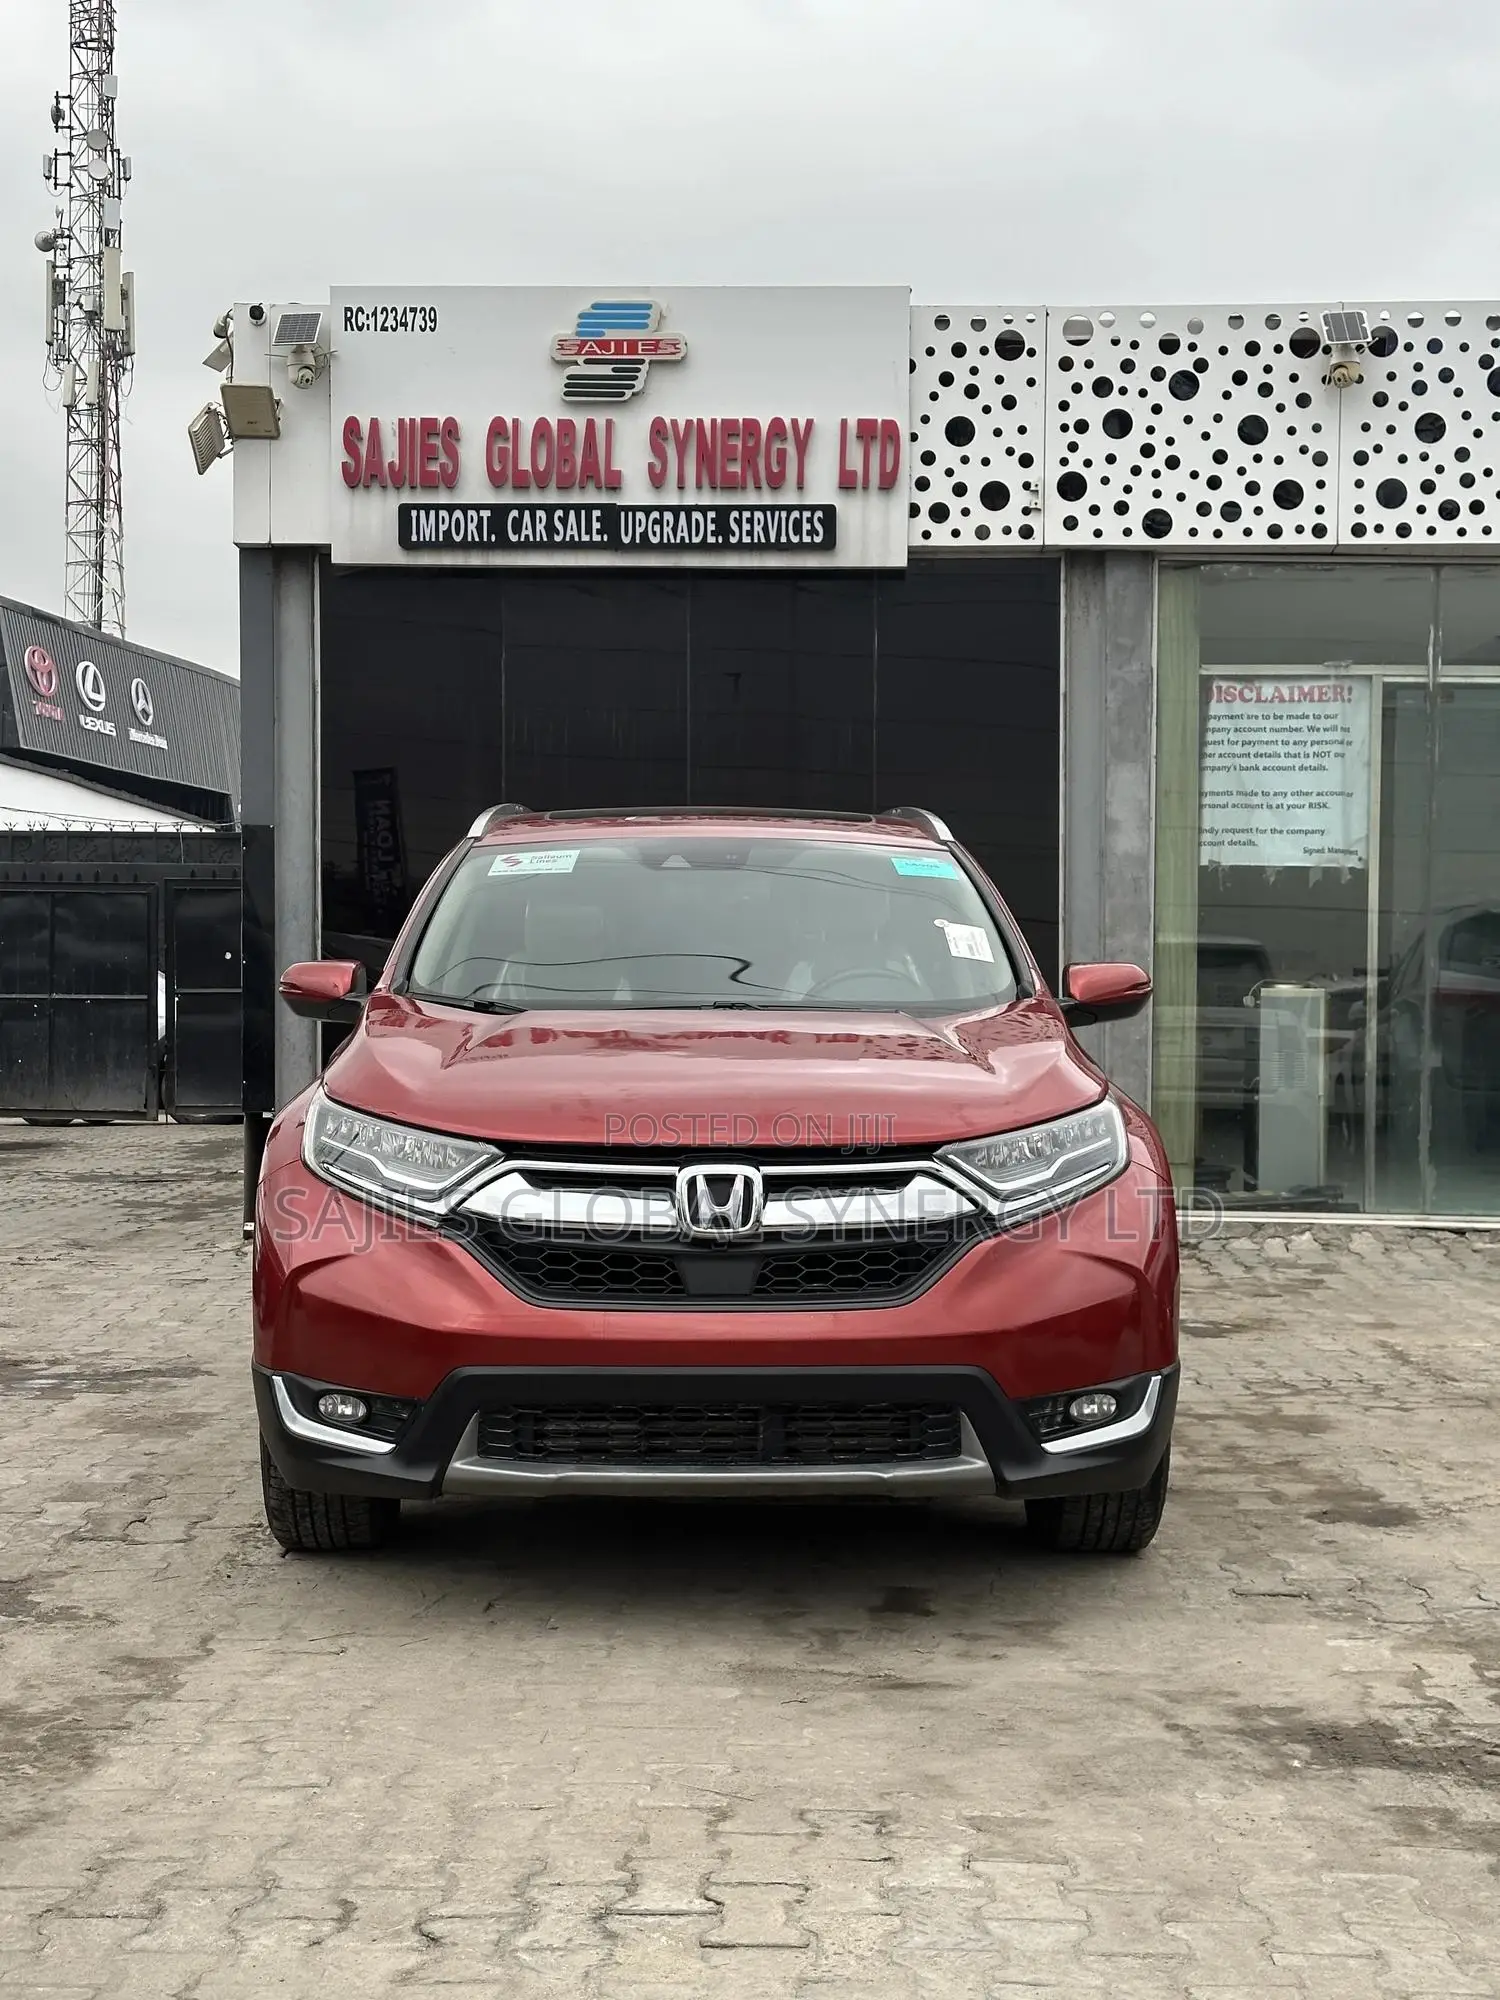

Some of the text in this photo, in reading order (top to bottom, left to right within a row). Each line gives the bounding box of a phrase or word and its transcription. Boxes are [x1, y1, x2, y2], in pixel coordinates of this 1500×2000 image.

[343, 306, 438, 333] RC:1234739
[555, 338, 682, 355] SAJIES
[341, 415, 901, 489] SAJIES GLOBAL SYNERGY LTD
[410, 510, 824, 544] IMPORT. CAR SALE. UPGRADE. SERVICES
[1208, 713, 1244, 722] payment
[1273, 712, 1284, 720] be
[1286, 712, 1311, 720] made
[79, 714, 117, 736] LEXUS
[1323, 725, 1338, 733] will
[1227, 738, 1239, 746] for
[1241, 739, 1279, 747] payment
[1292, 740, 1308, 748] any
[1253, 751, 1282, 759] details
[1284, 751, 1300, 759] that
[1303, 751, 1310, 759] is
[1312, 751, 1332, 759] NOT
[1239, 764, 1260, 772] bank
[1236, 789, 1259, 797] made
[1290, 789, 1314, 797] other
[1266, 802, 1274, 810] is
[1270, 827, 1284, 835] the
